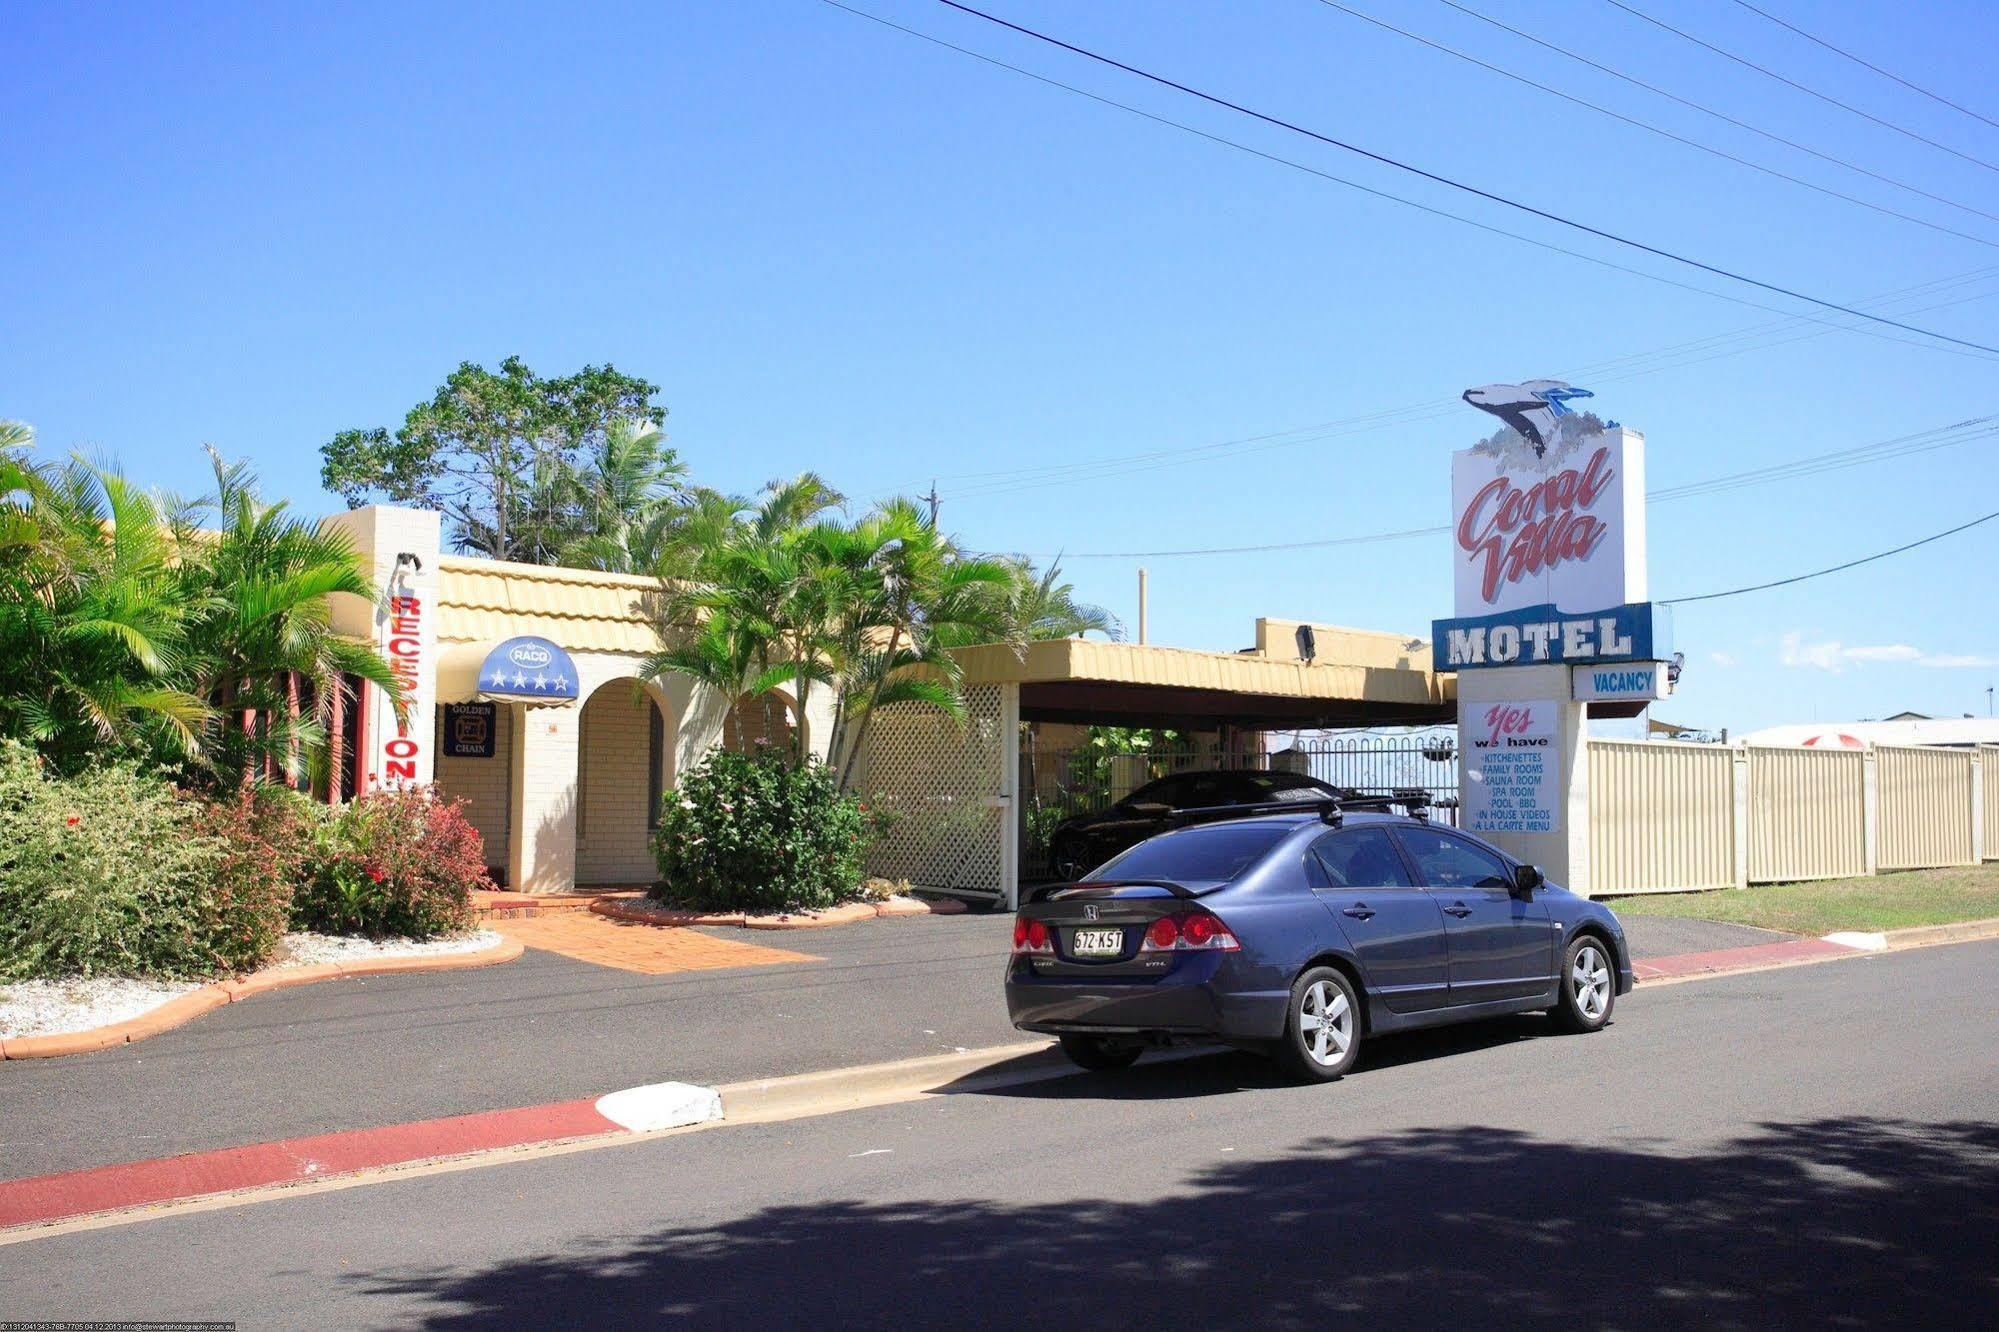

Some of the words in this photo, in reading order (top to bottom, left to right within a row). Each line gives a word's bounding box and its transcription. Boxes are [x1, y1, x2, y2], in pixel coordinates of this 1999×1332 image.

[1458, 447, 1612, 551] Coral
[1469, 509, 1607, 603] Villa
[1446, 618, 1632, 664] MOTEL
[1593, 671, 1653, 692] VACANCY
[452, 705, 491, 716] GOLDEN
[1475, 739, 1499, 748] we
[1507, 737, 1549, 748] have
[455, 743, 485, 754] CHAIN
[1484, 752, 1542, 763] KITCHENETTES
[1483, 764, 1511, 774] FAMILY
[1514, 764, 1543, 774] ROOMS
[1485, 776, 1512, 786] SAUNA
[1516, 775, 1542, 785] ROOM
[1492, 787, 1507, 797] SPA
[1510, 787, 1535, 797] ROOM
[1491, 799, 1513, 808] POOL
[1479, 810, 1487, 819] IN
[1491, 810, 1517, 819] HOUSE
[1520, 810, 1551, 820] VIDEOS
[1485, 821, 1495, 831] LA
[1498, 821, 1524, 831] CARTE
[1526, 821, 1550, 831] MENU
[1075, 932, 1096, 948] 672
[1098, 932, 1122, 948] KST
